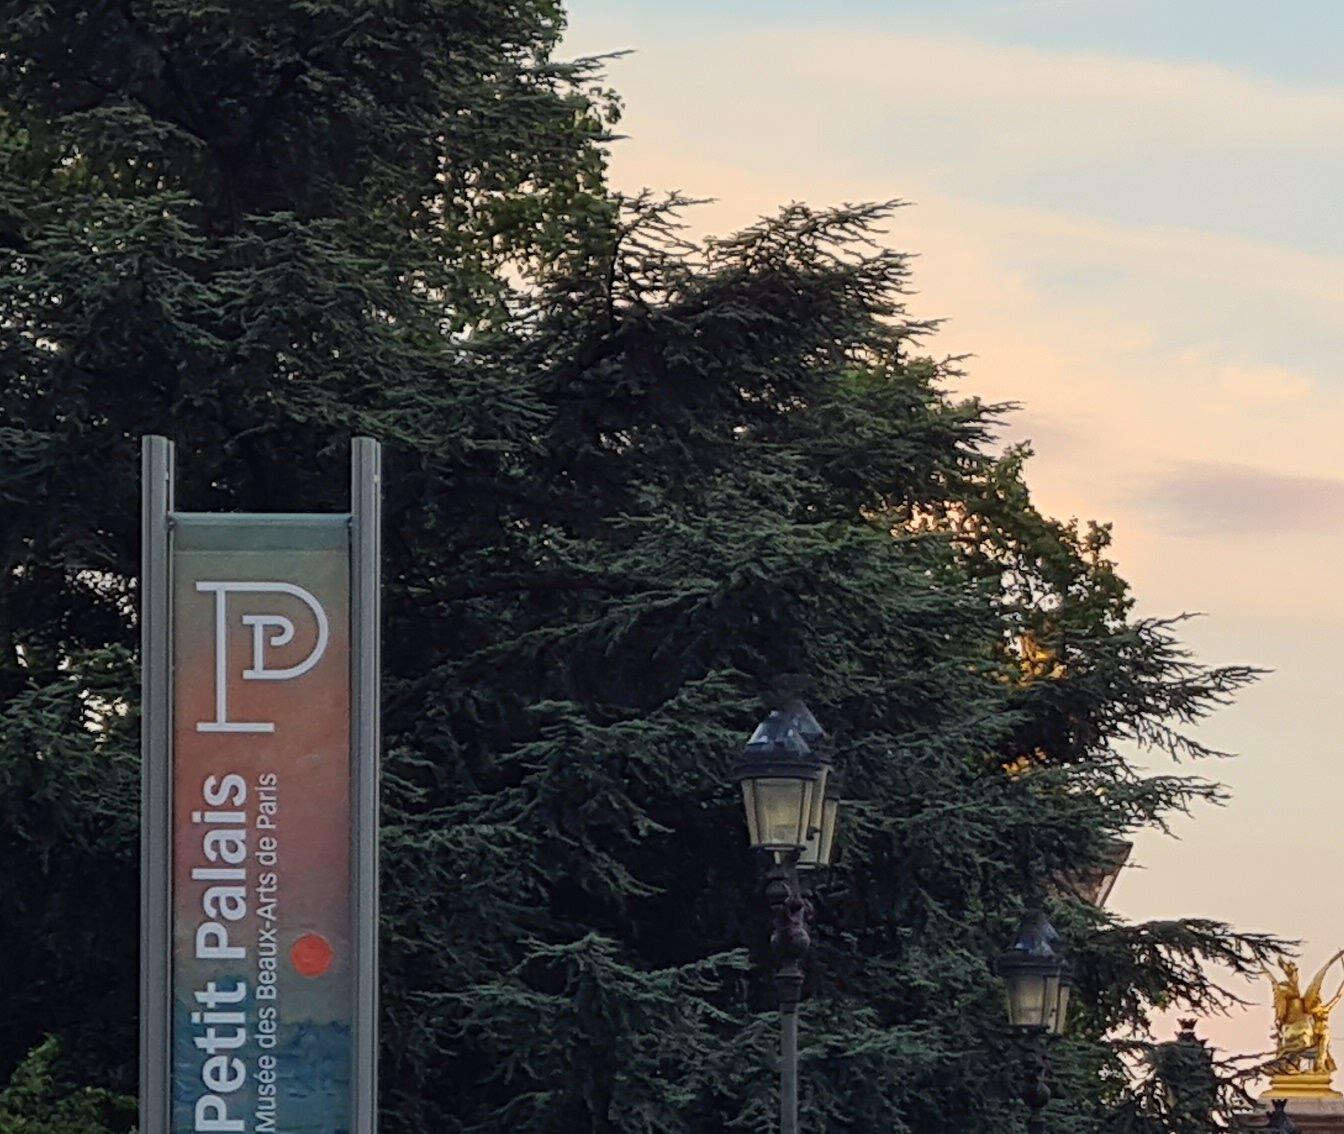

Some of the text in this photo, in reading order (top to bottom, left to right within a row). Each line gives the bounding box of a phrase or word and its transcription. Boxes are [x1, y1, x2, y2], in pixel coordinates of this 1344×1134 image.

[191, 773, 248, 1132] Petit Palais
[253, 772, 278, 1132] Musée des Beaux-Arts de Paris
